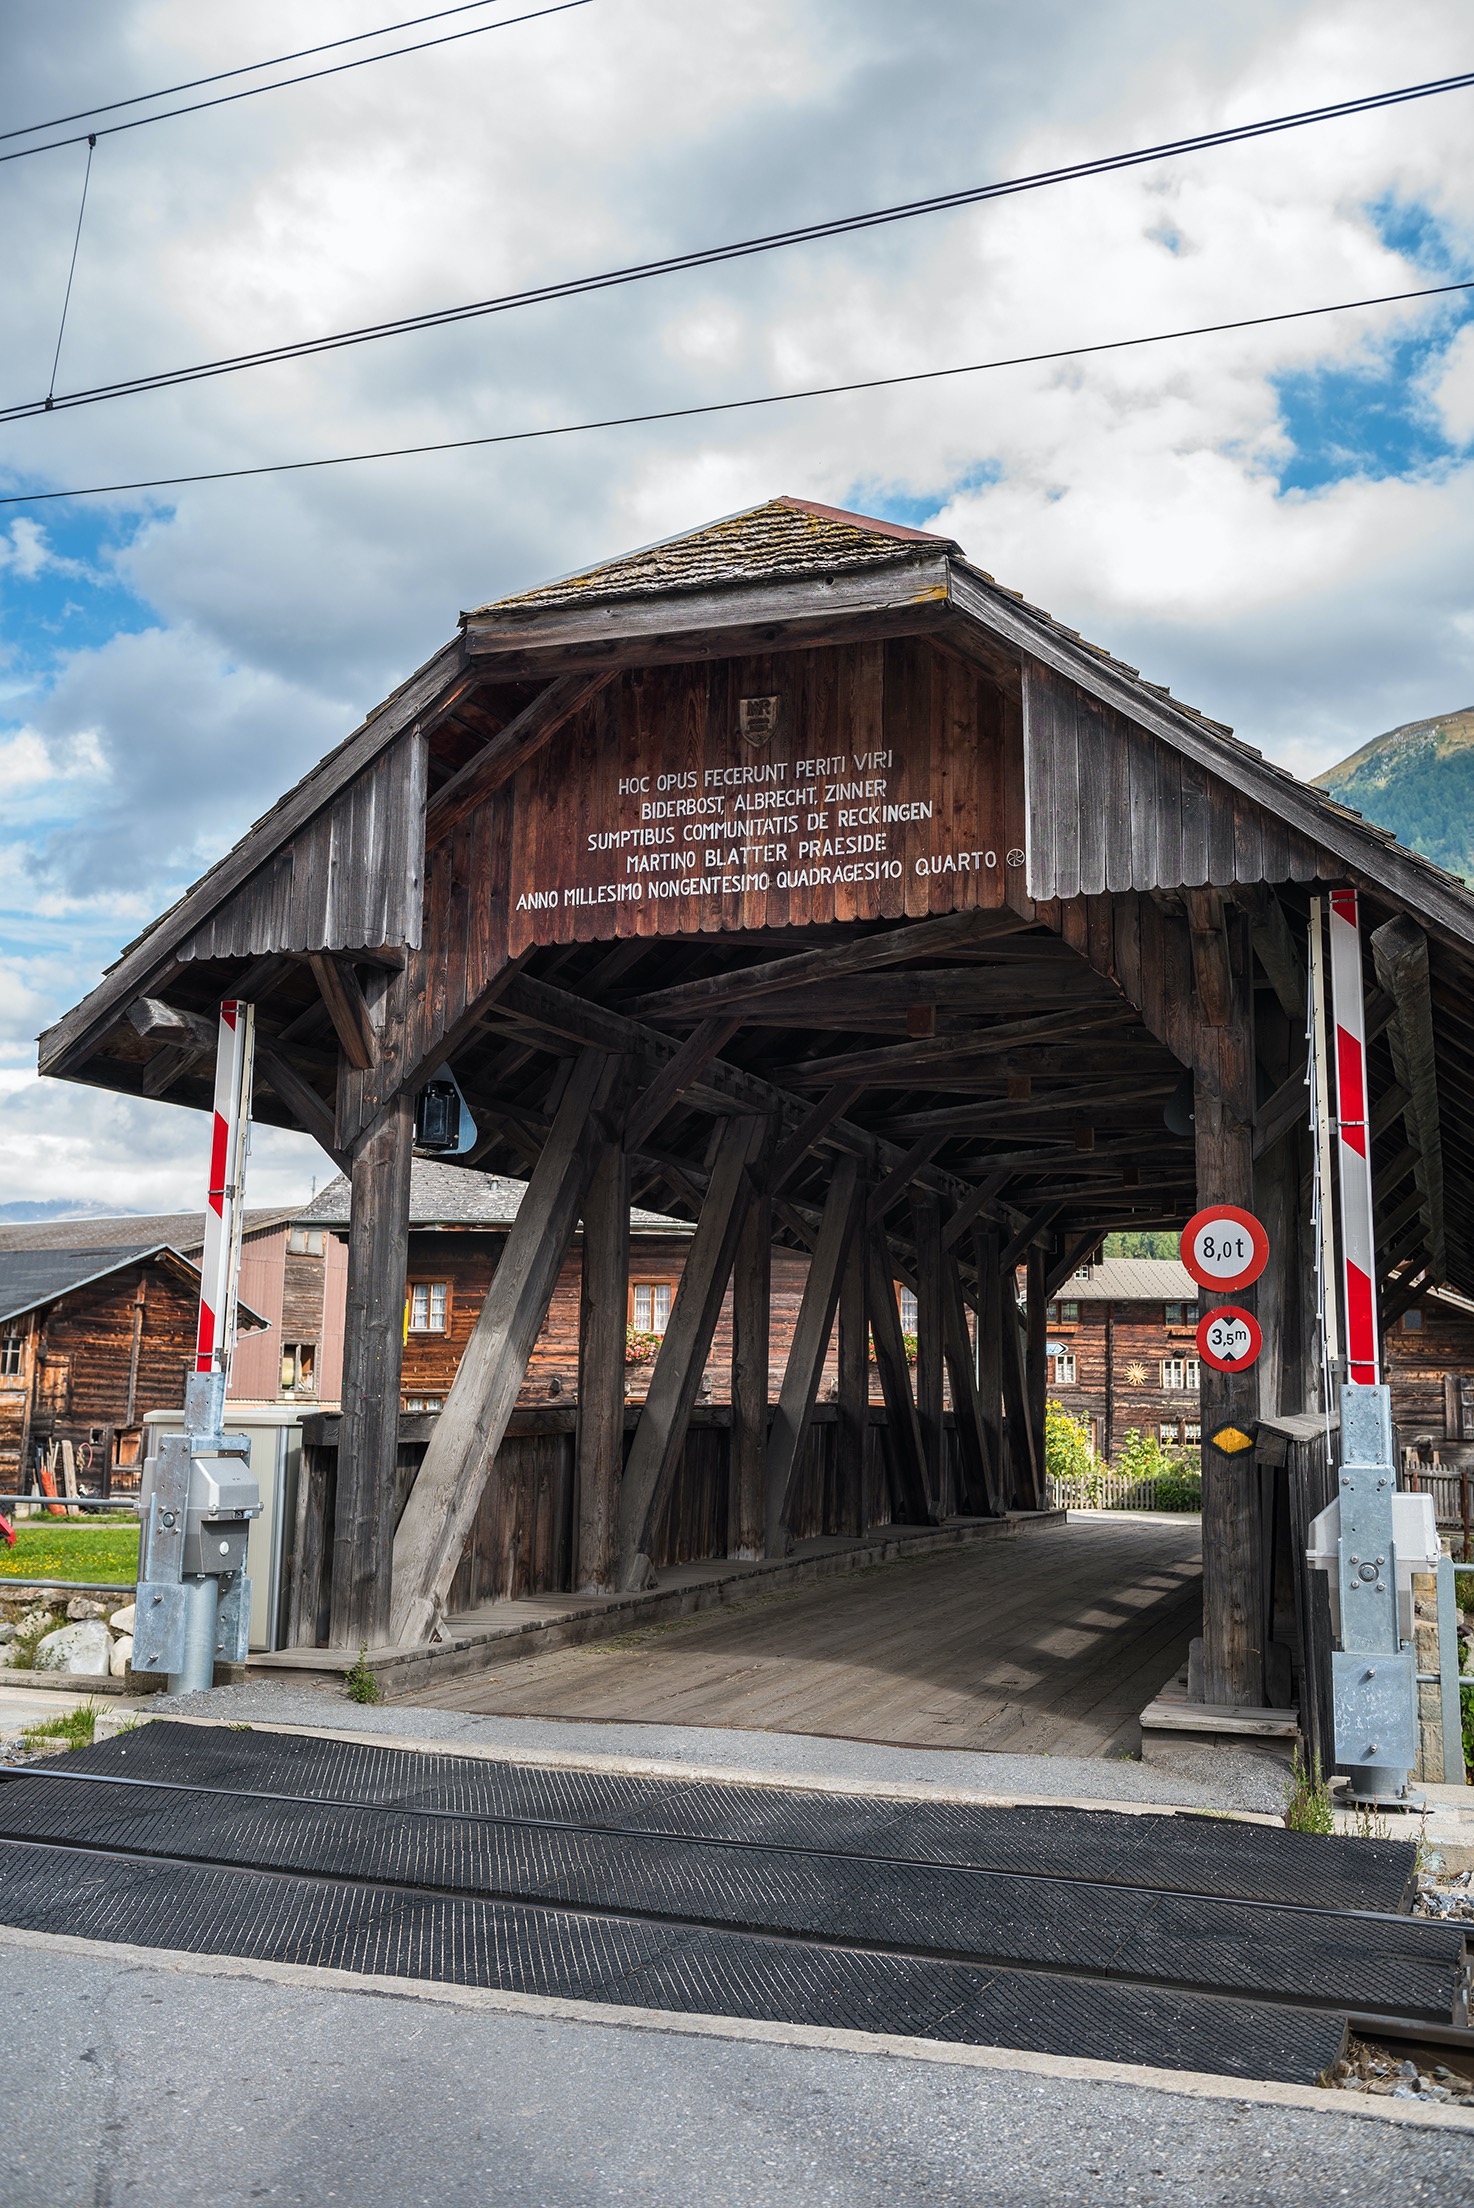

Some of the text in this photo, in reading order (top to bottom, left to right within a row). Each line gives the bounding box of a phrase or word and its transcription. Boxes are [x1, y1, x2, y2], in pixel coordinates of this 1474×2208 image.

[618, 750, 893, 795] HOC OPUS FECERUNT PERITI VIRI
[641, 779, 887, 820] BIDERBOST, ALBRECHT, ZINNER
[587, 800, 933, 851] SUMPTIBUS COMMUNITATIS DE RECKINGEN
[626, 833, 887, 874] MARTINO BLATTER PRAESIDE
[516, 890, 559, 911] ANNO
[564, 882, 643, 907] MILLESIMO
[648, 871, 769, 899] NONGENTESIMO
[915, 850, 997, 876] QUARTO
